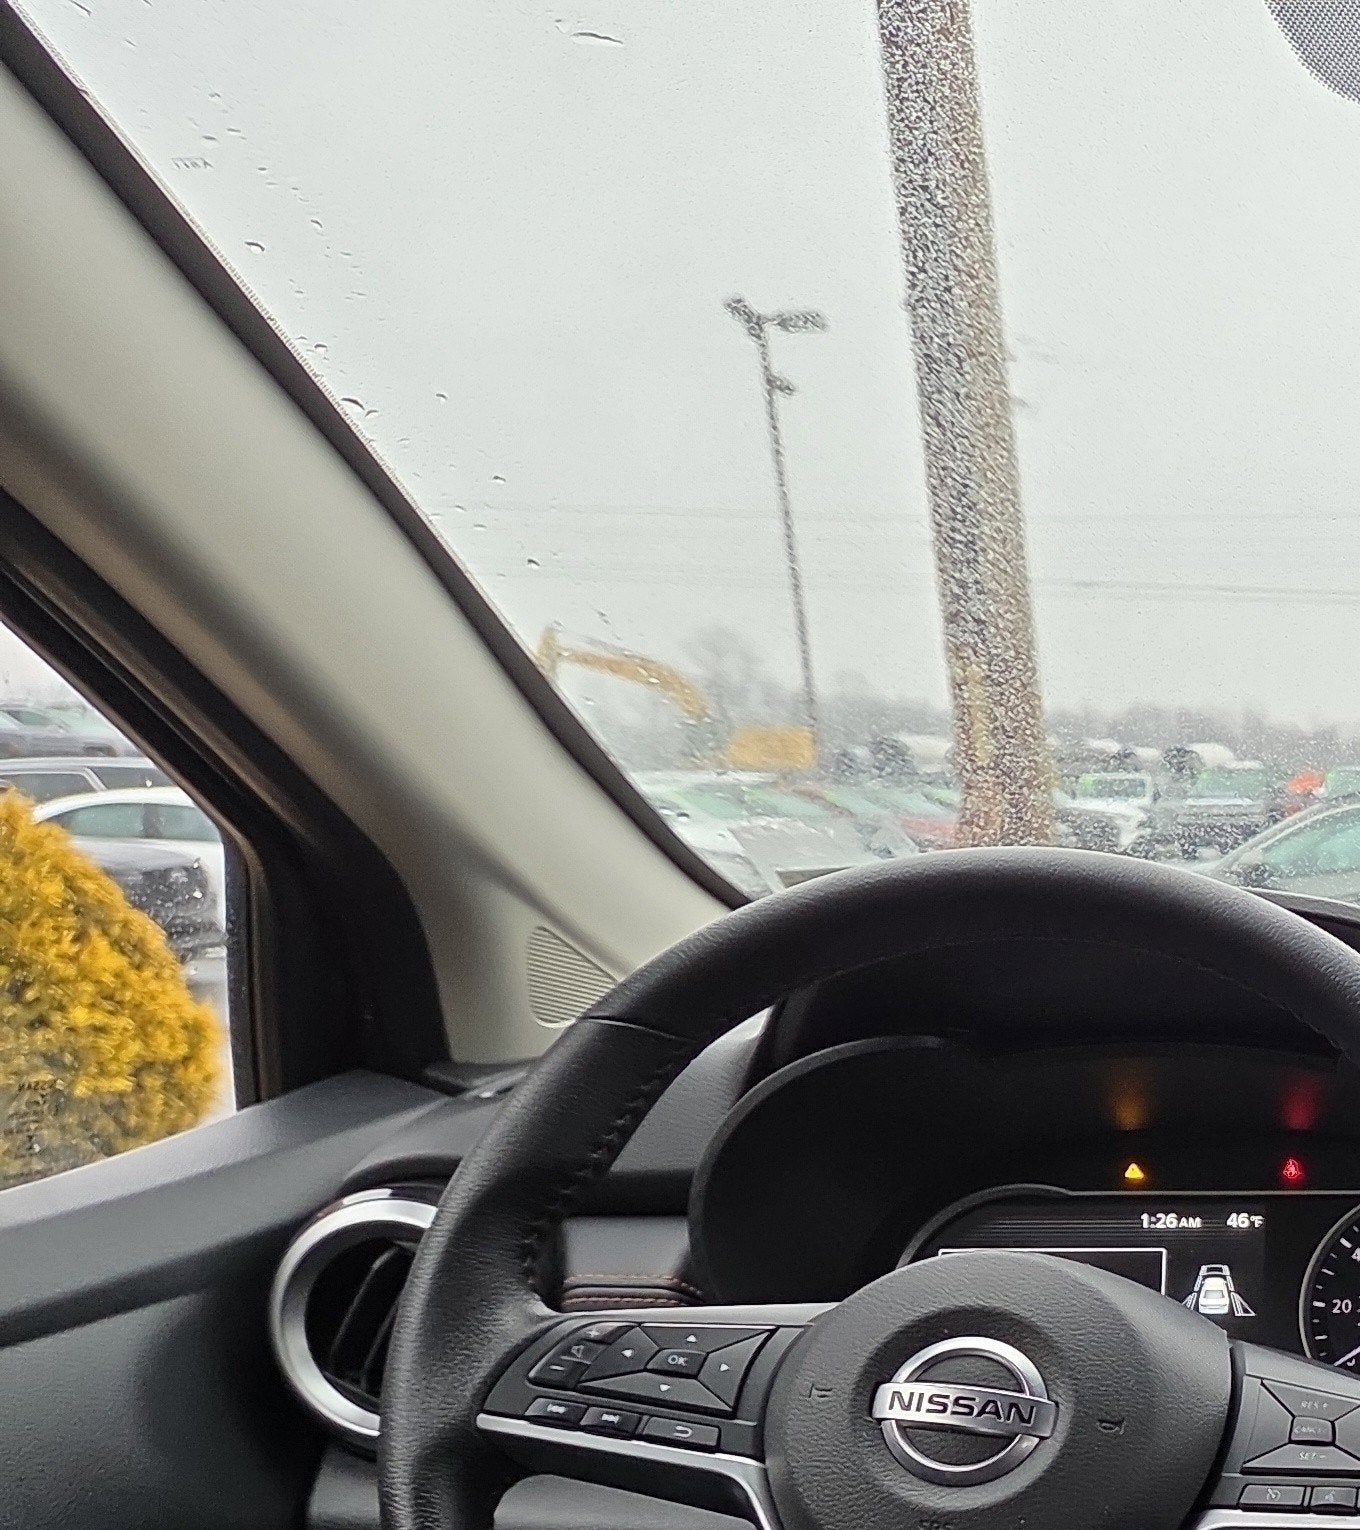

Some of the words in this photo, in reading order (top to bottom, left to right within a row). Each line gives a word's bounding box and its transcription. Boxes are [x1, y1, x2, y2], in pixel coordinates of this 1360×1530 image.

[1332, 1299, 1352, 1314] 20
[667, 1354, 689, 1367] OK
[888, 1390, 1037, 1426] NISSAN
